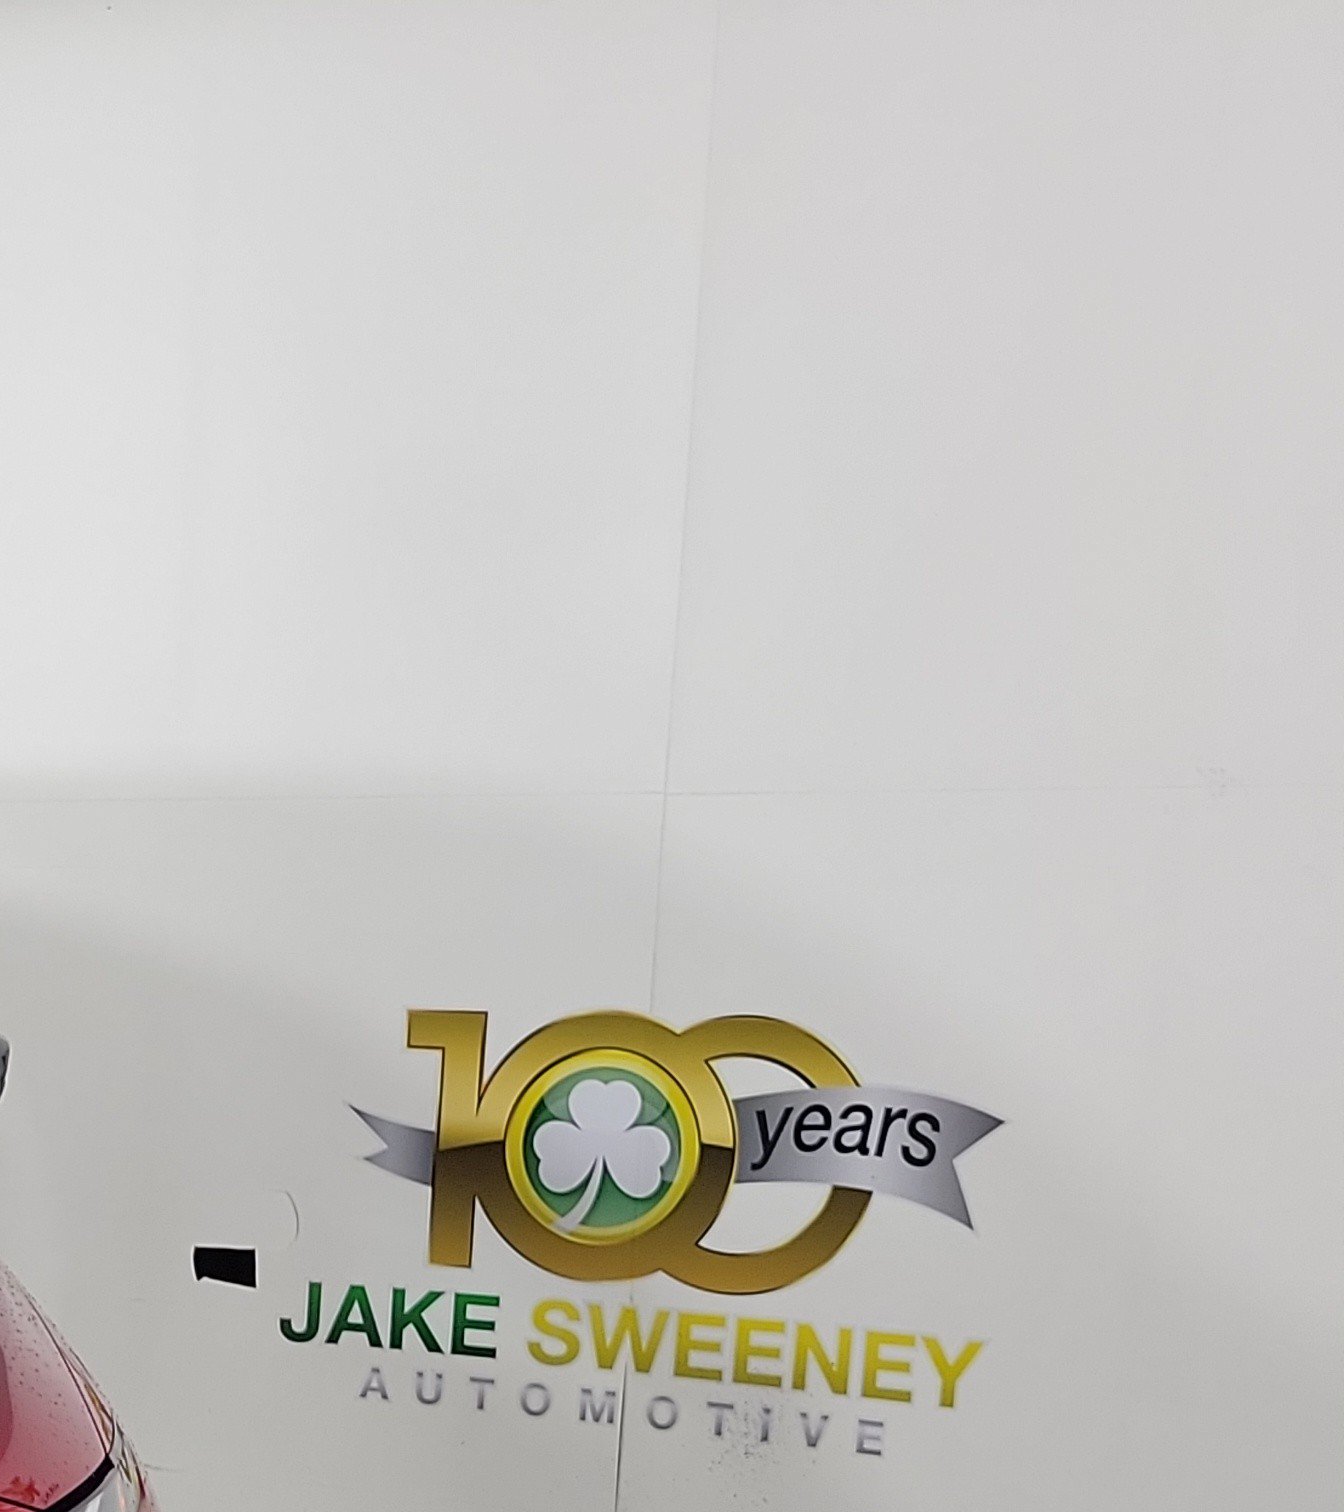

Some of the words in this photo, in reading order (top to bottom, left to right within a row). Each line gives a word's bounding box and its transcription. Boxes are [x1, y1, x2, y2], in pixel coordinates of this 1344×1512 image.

[405, 1008, 874, 1295] 100
[749, 1103, 942, 1172] years
[278, 1281, 501, 1359] JAKE
[526, 1299, 984, 1409] SWEENEY
[358, 1366, 886, 1456] AUTOMOTIVE
